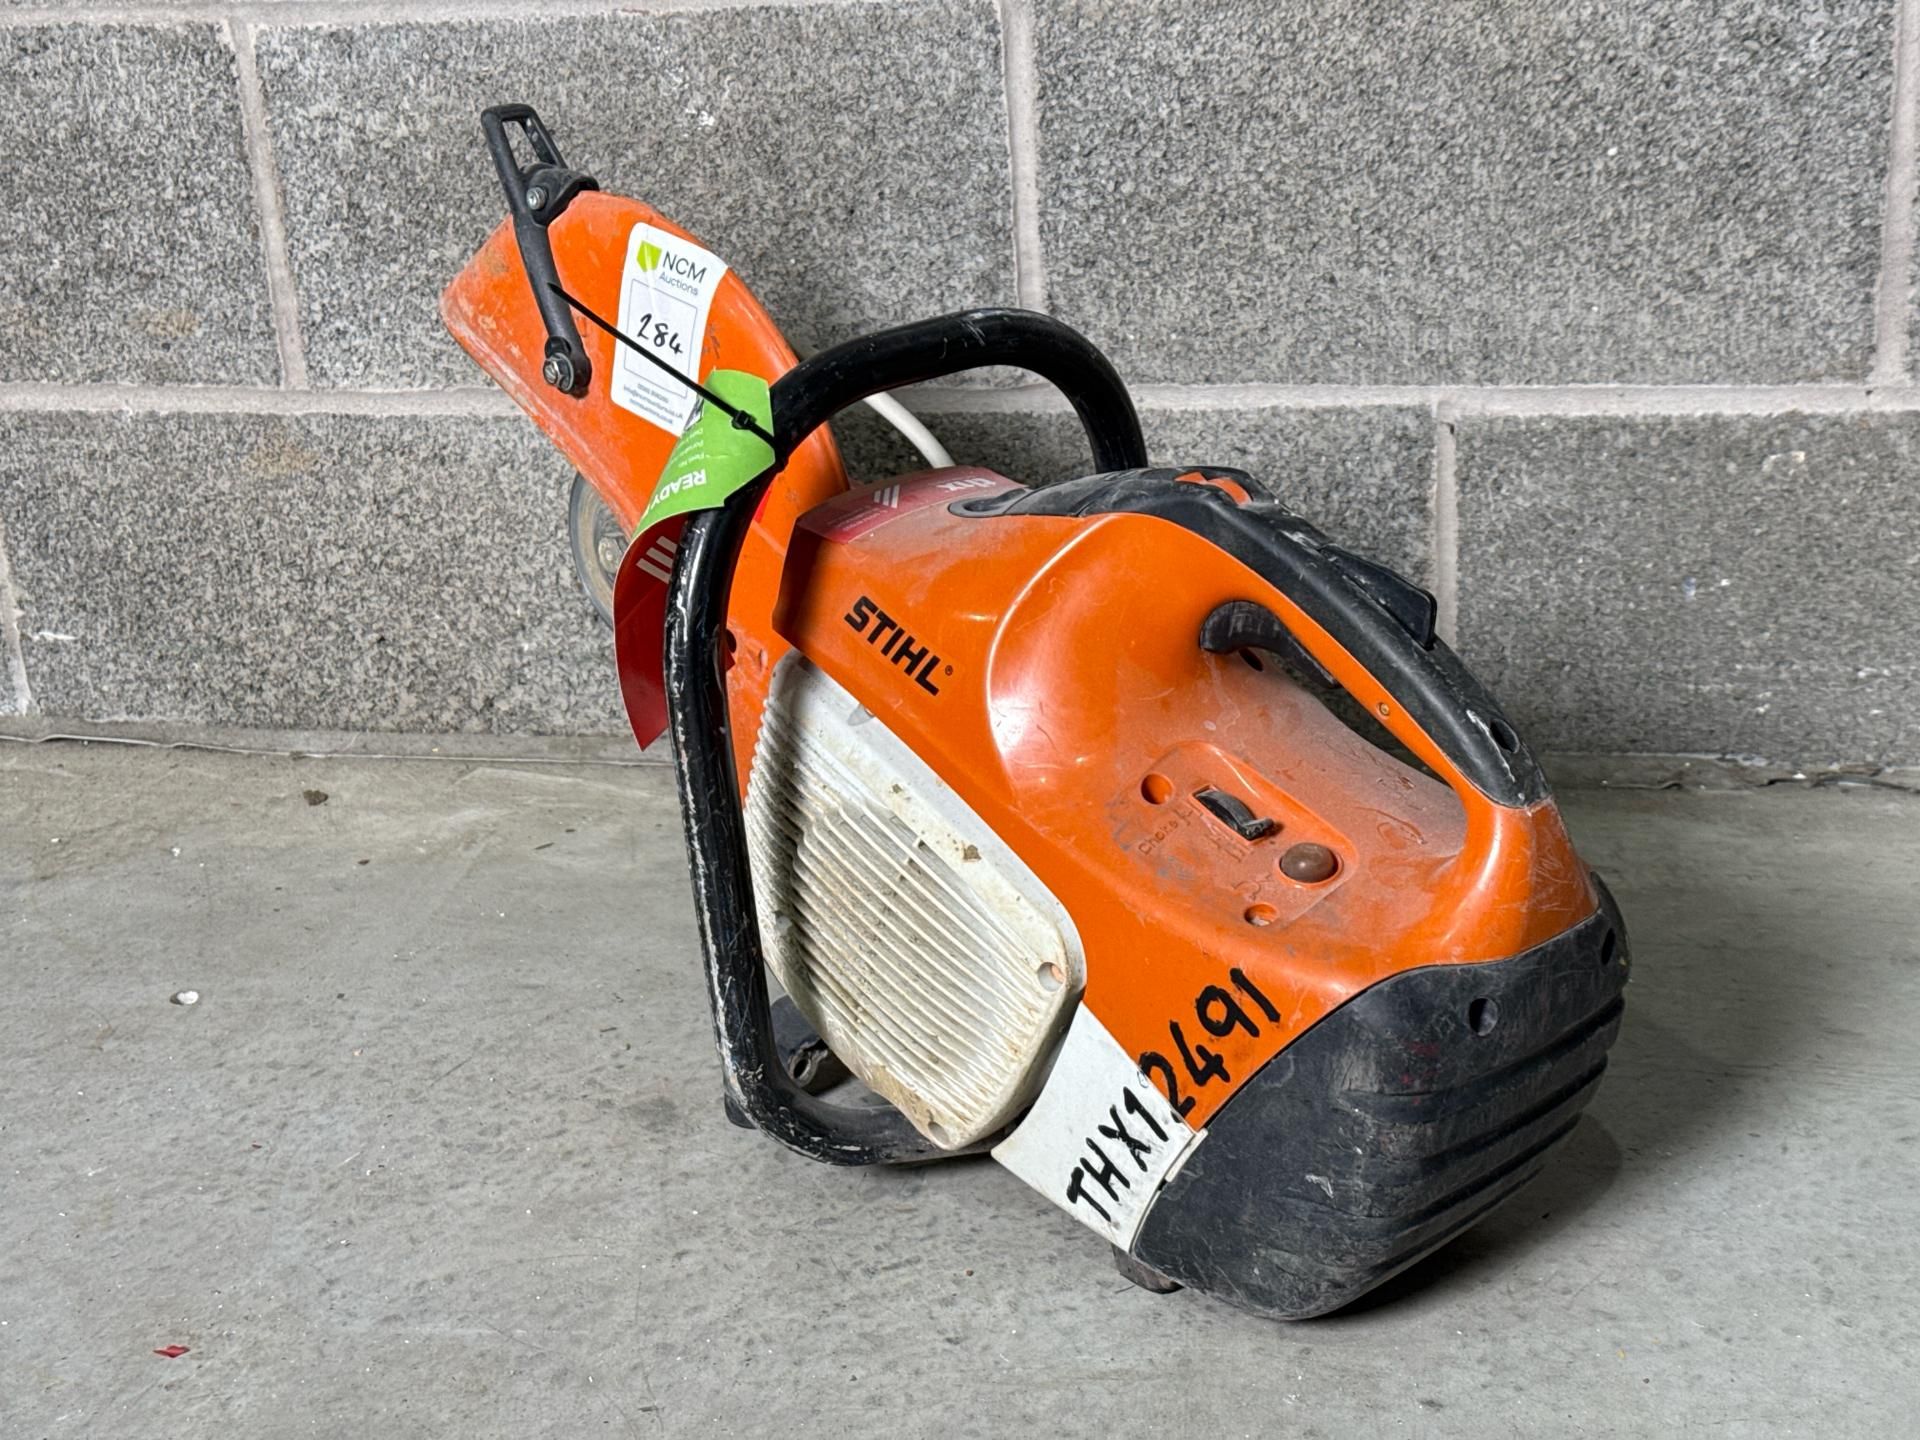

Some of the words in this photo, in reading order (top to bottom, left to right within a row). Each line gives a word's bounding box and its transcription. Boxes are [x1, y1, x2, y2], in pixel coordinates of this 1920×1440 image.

[658, 271, 699, 297] Auctions
[662, 250, 708, 283] NCM
[637, 312, 684, 354] 284
[650, 468, 707, 510] READY
[843, 595, 942, 697] STIHL
[1065, 967, 1282, 1222] THX12491
